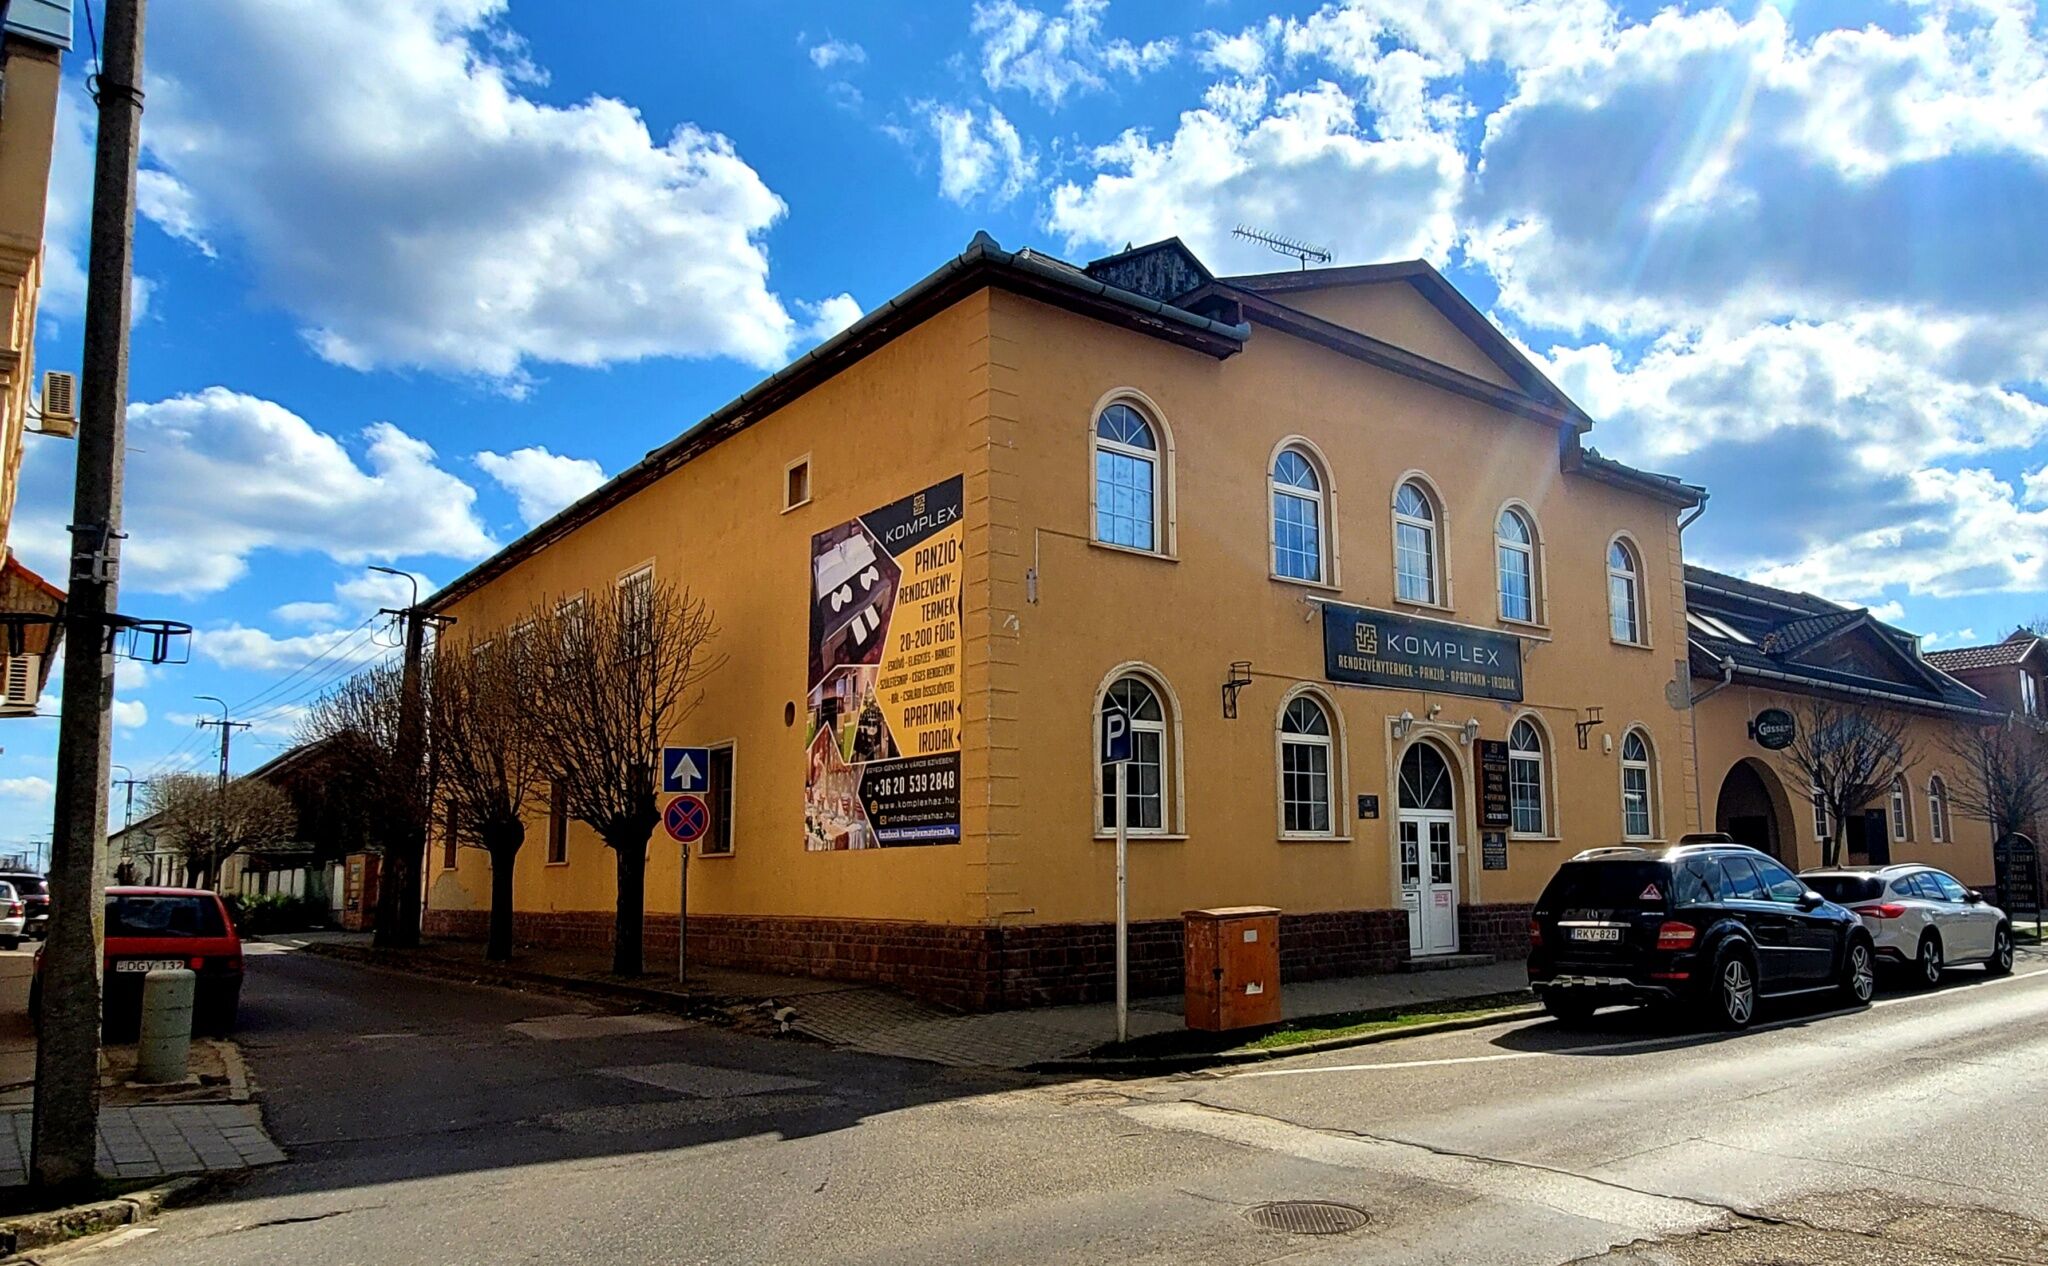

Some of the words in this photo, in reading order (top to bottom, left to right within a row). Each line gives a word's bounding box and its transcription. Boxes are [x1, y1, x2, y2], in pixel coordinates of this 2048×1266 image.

[885, 504, 957, 544] KOMPLEX
[915, 533, 956, 575] PANZIÓ
[921, 596, 955, 623] TERMEK
[900, 627, 932, 652] 20-200
[1387, 632, 1500, 667] KOMPLEX
[1338, 654, 1414, 678] RENDEZVÉNYTERMEK
[1419, 665, 1445, 681] PANZIÓ
[904, 699, 955, 729] APARTMAN
[918, 724, 954, 753] IRODÁK
[1107, 714, 1125, 757] P
[874, 778, 891, 796] +36
[893, 776, 905, 795] 20
[909, 774, 927, 793] 539
[929, 770, 955, 791] 2848
[1576, 929, 1618, 940] RKV-828
